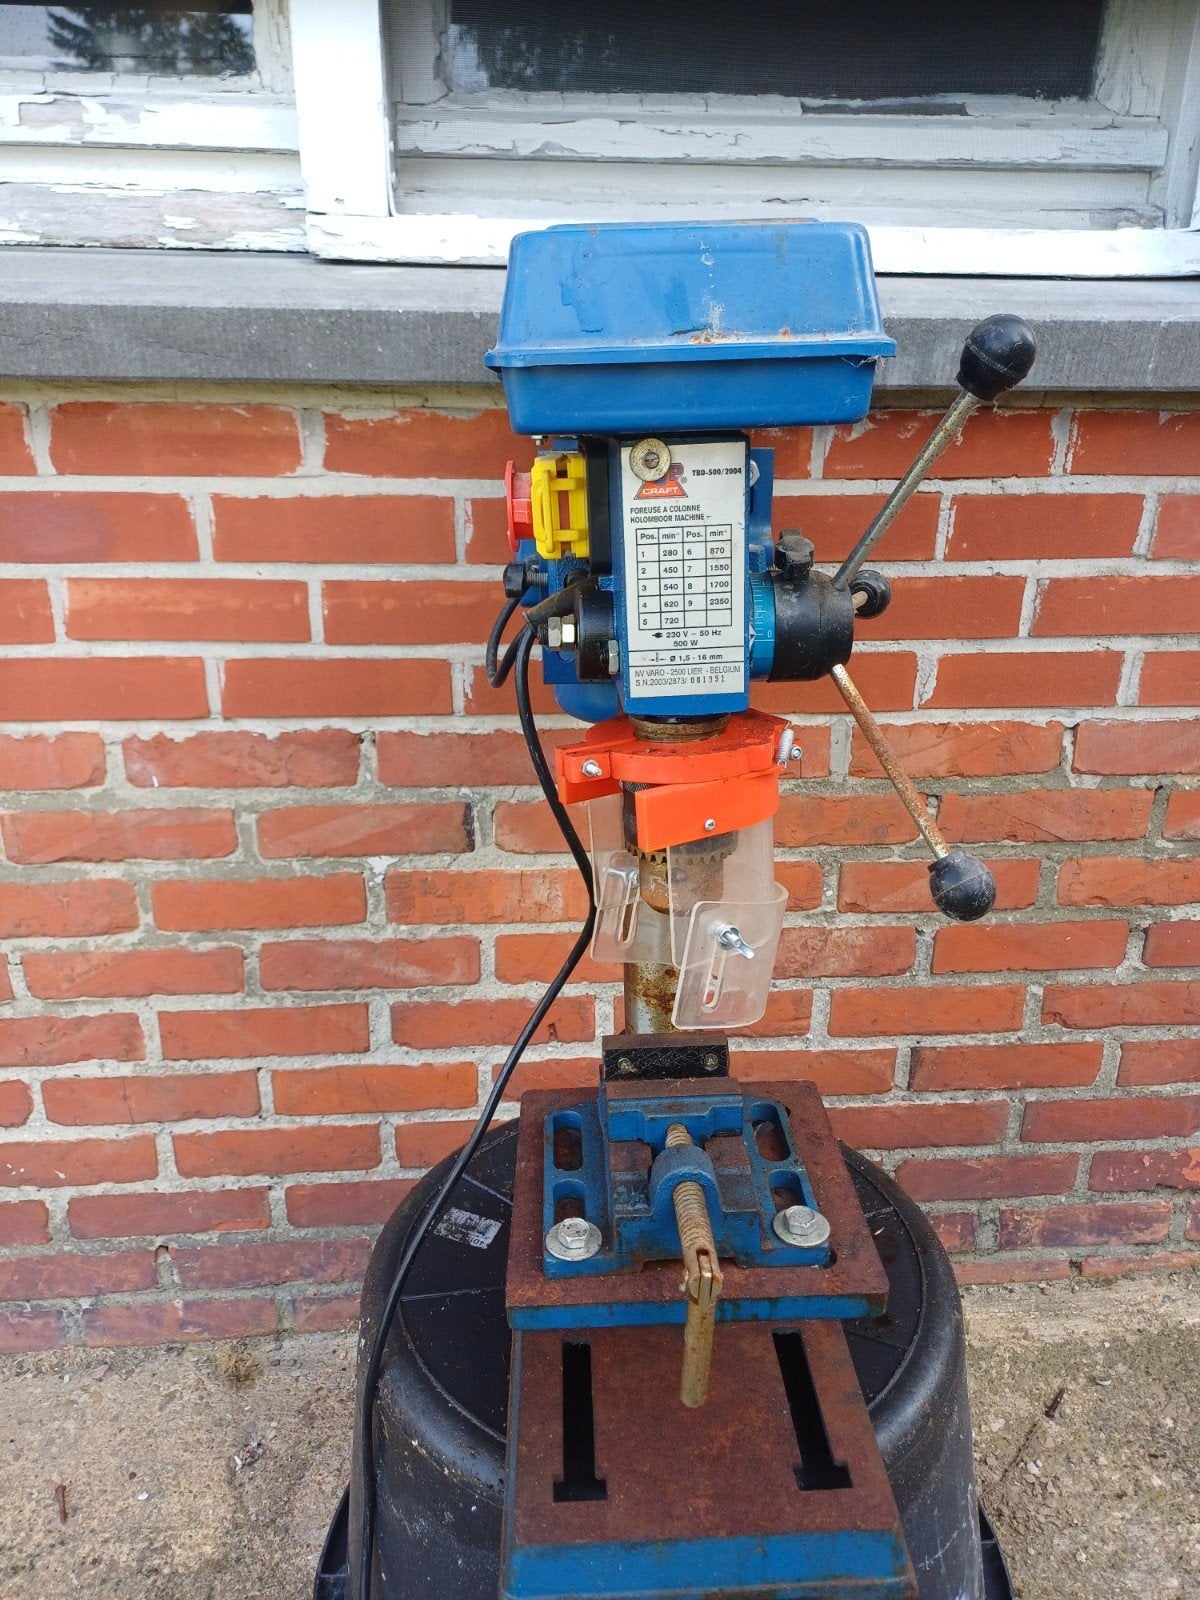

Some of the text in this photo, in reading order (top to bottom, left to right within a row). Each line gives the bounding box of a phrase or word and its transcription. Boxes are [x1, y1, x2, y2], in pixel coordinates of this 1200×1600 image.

[692, 468, 742, 476] TBD-500/2004
[642, 487, 679, 495] CRAFT
[630, 506, 661, 514] FOREUSE
[630, 515, 672, 523] KOLOMBOOR
[710, 580, 729, 588] 1700
[670, 668, 686, 676] 2500
[688, 666, 703, 675] LIER
[710, 666, 741, 674] BELGIUM
